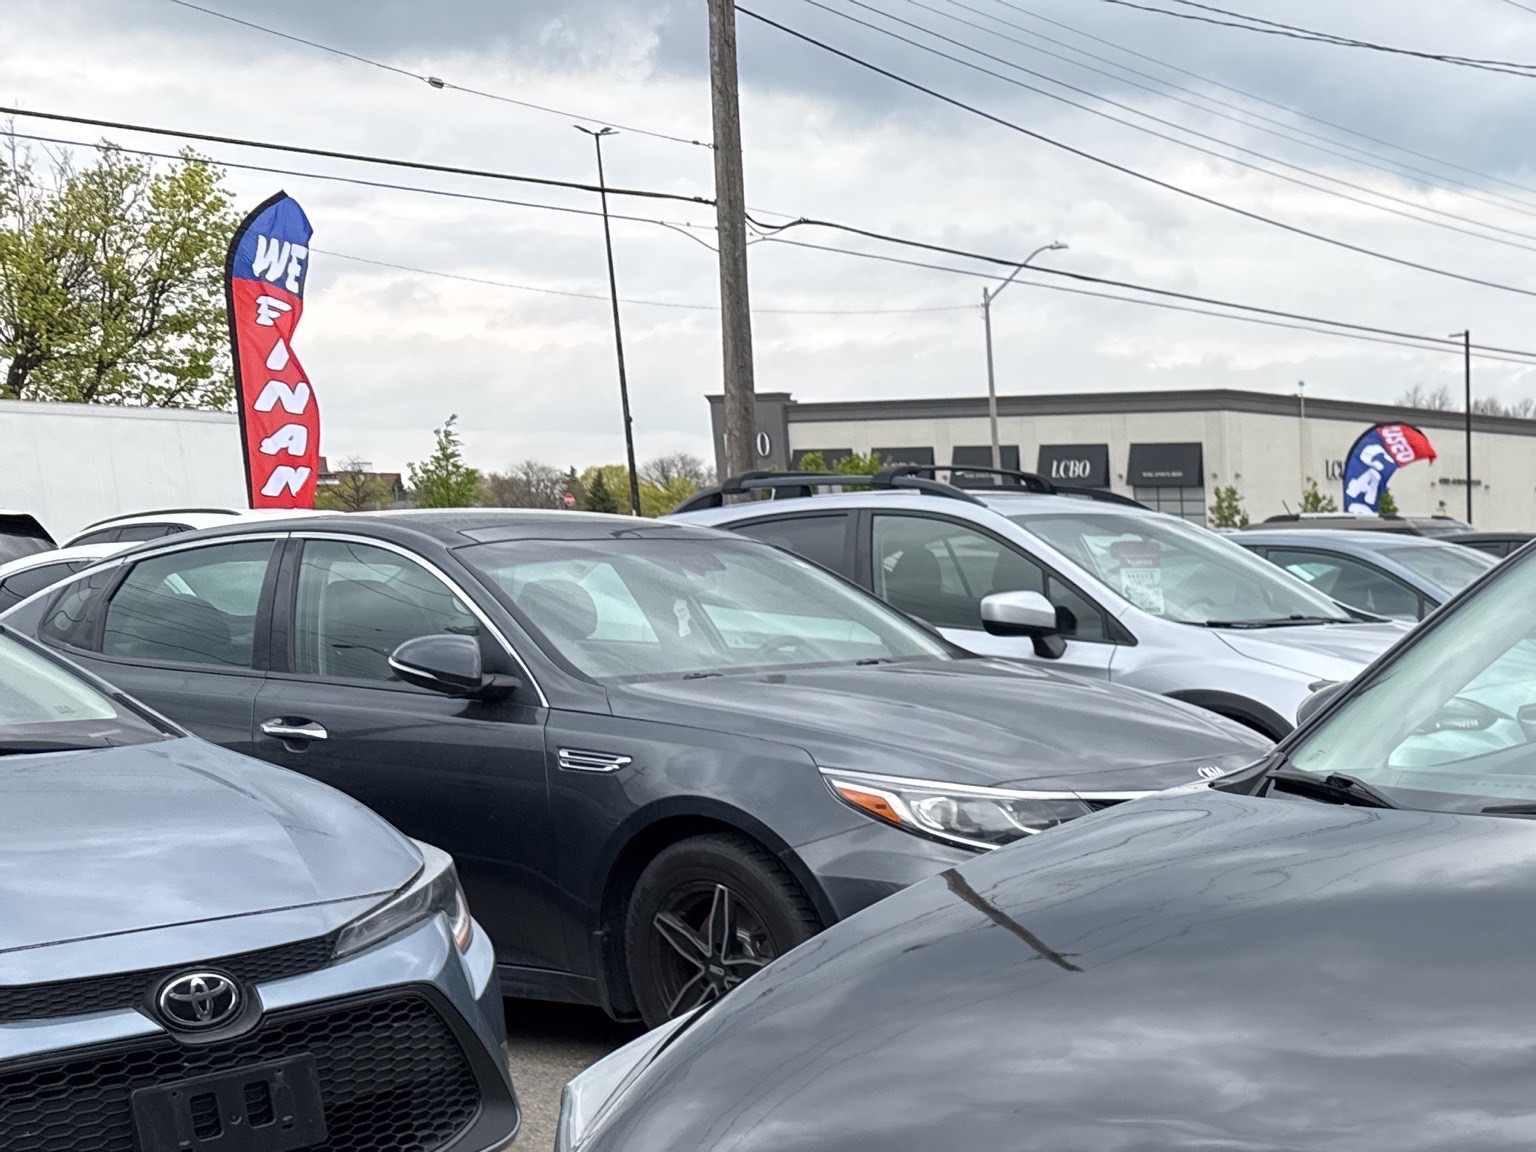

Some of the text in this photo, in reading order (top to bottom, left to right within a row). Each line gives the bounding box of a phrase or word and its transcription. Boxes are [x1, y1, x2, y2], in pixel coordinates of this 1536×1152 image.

[252, 234, 308, 294] WE
[1381, 425, 1416, 463] USED
[1051, 459, 1091, 479] LCBO
